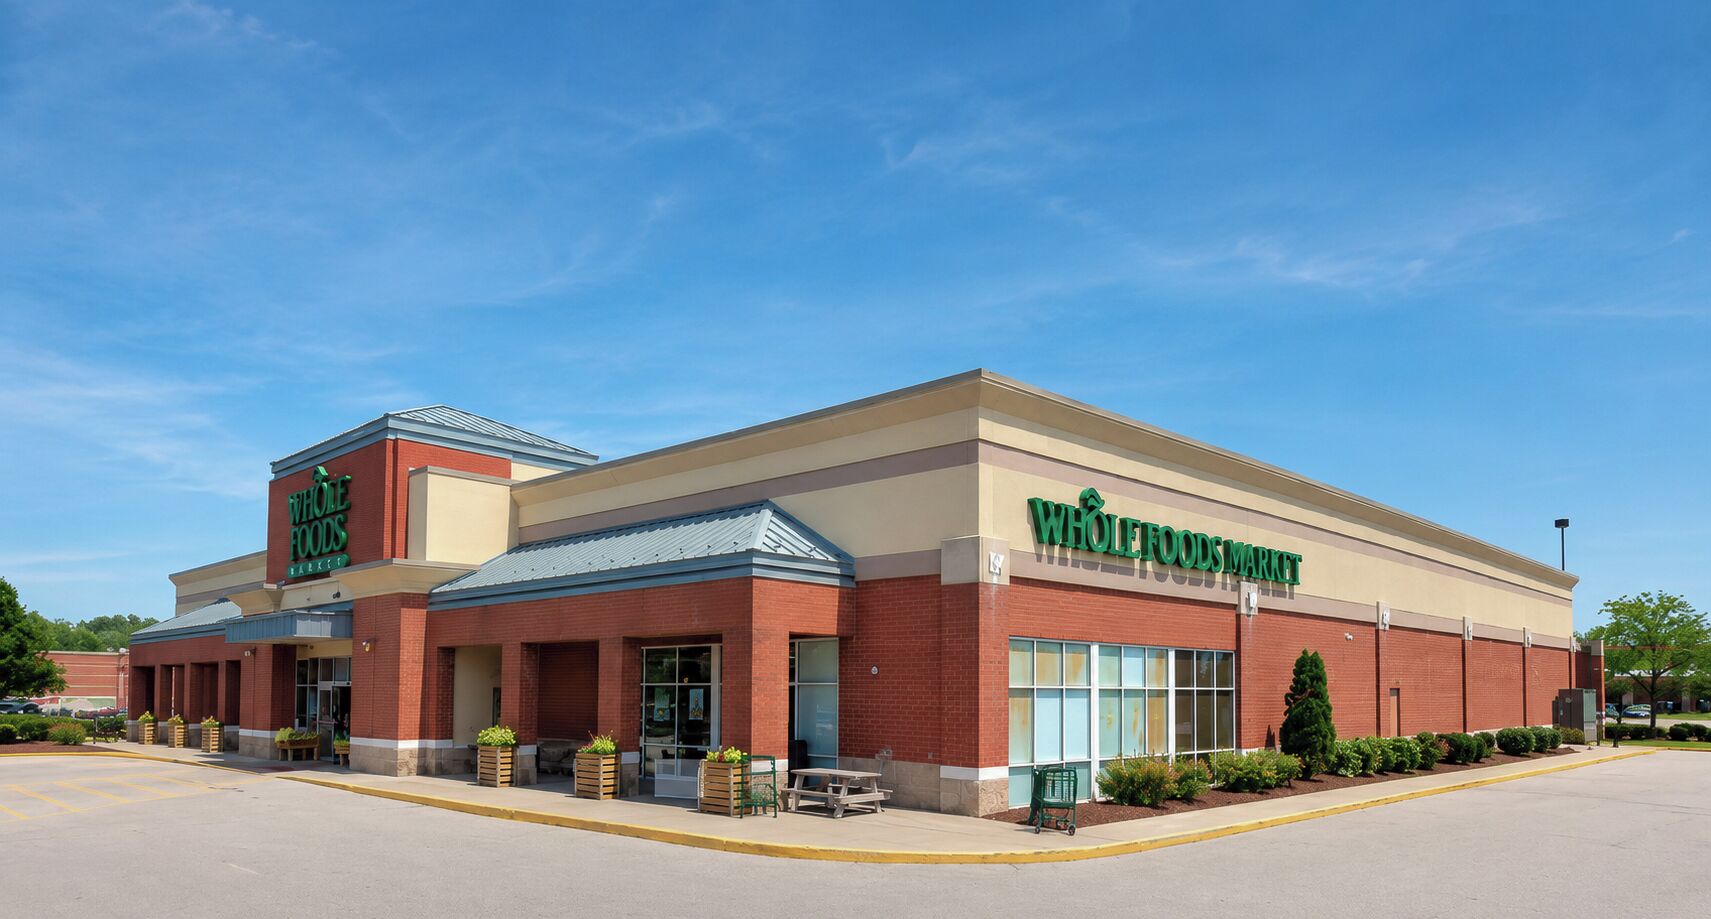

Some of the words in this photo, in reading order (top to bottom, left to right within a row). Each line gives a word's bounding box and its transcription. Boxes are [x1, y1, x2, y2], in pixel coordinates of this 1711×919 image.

[288, 466, 352, 525] WHOLE
[290, 514, 348, 561] FOODS
[1028, 488, 1141, 558] WHOLE
[1141, 522, 1223, 572] FOODS
[1223, 539, 1302, 585] MARKET
